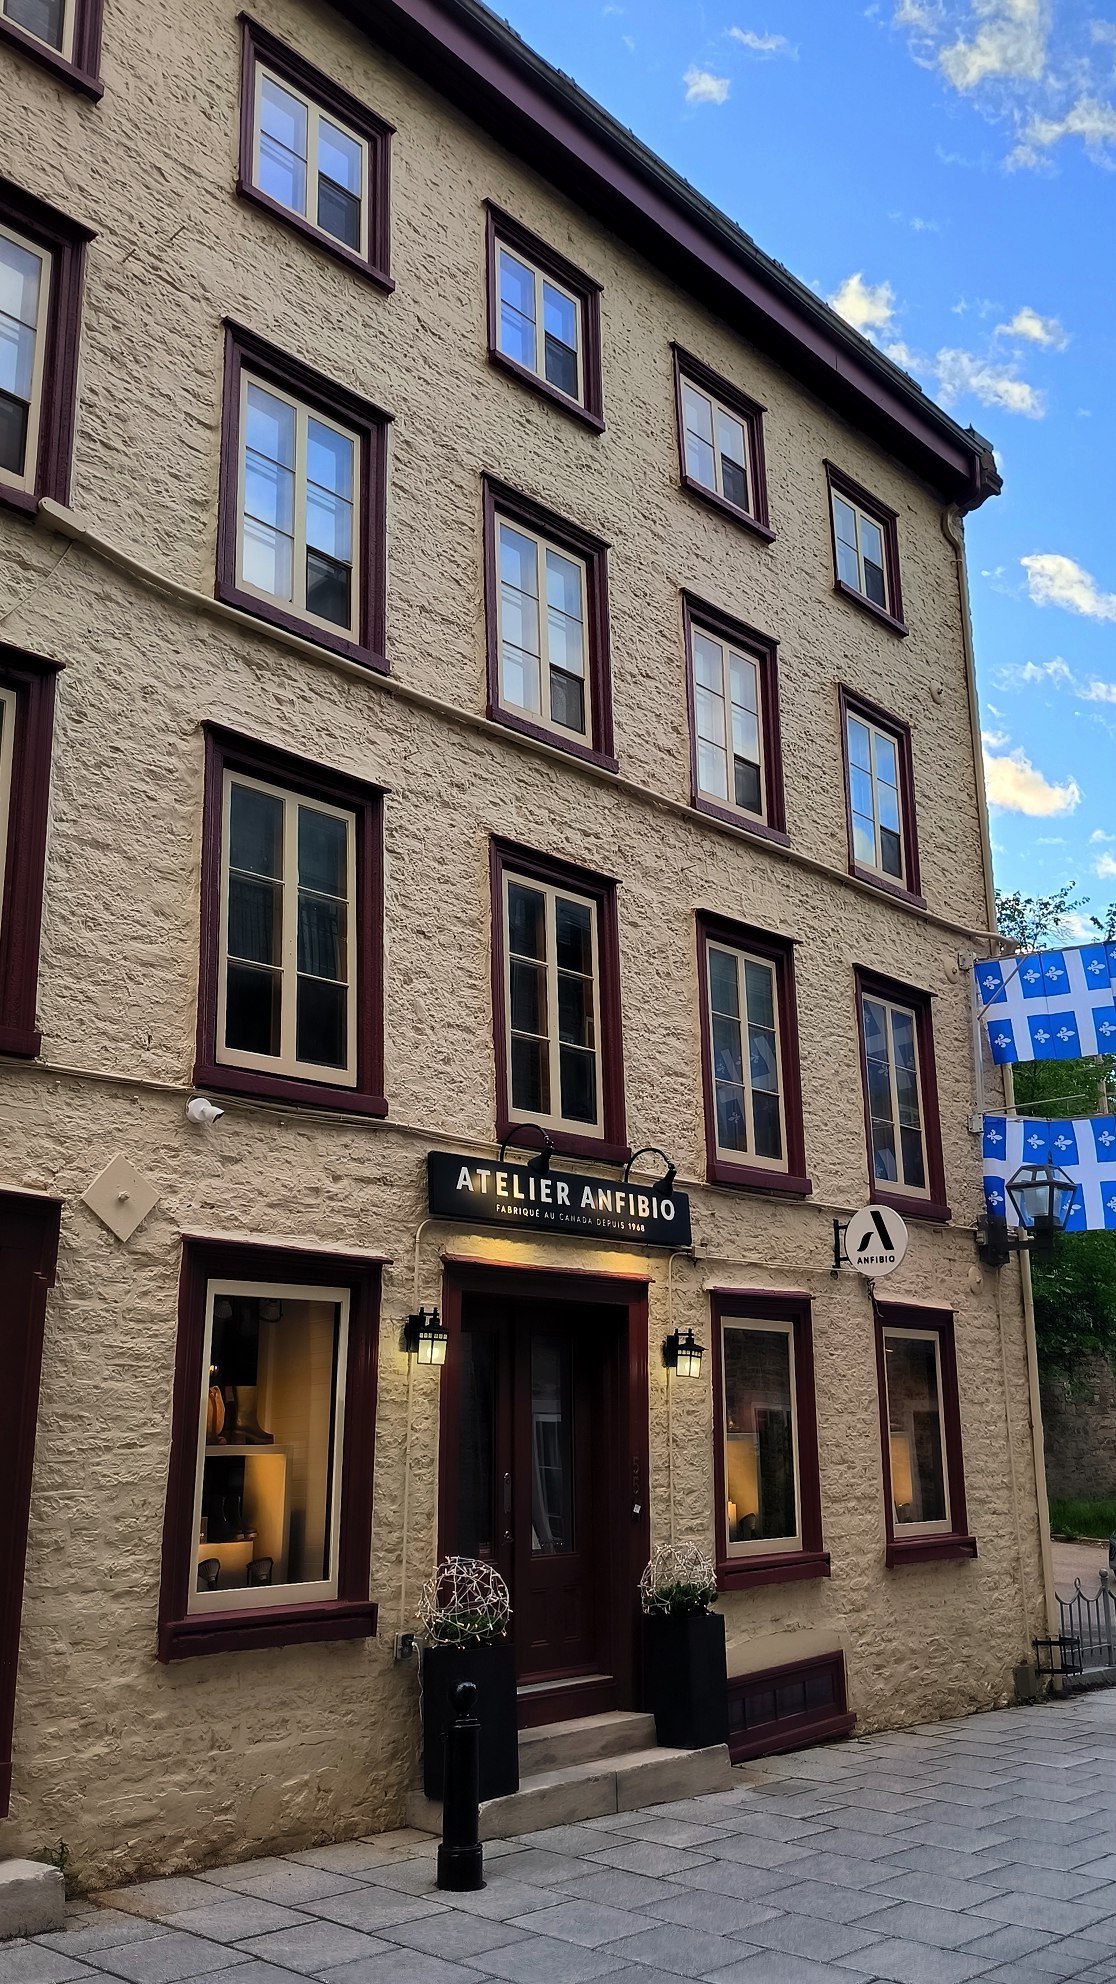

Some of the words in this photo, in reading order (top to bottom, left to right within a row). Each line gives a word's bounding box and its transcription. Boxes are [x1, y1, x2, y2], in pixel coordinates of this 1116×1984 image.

[456, 1166, 571, 1206] ATELIER
[580, 1186, 676, 1221] ANFIBIO
[544, 1211, 555, 1220] AU
[559, 1213, 593, 1225] CANADA
[596, 1218, 625, 1230] DEPUIS
[627, 1222, 646, 1233] 1968
[857, 1255, 895, 1265] ANFIBIO
